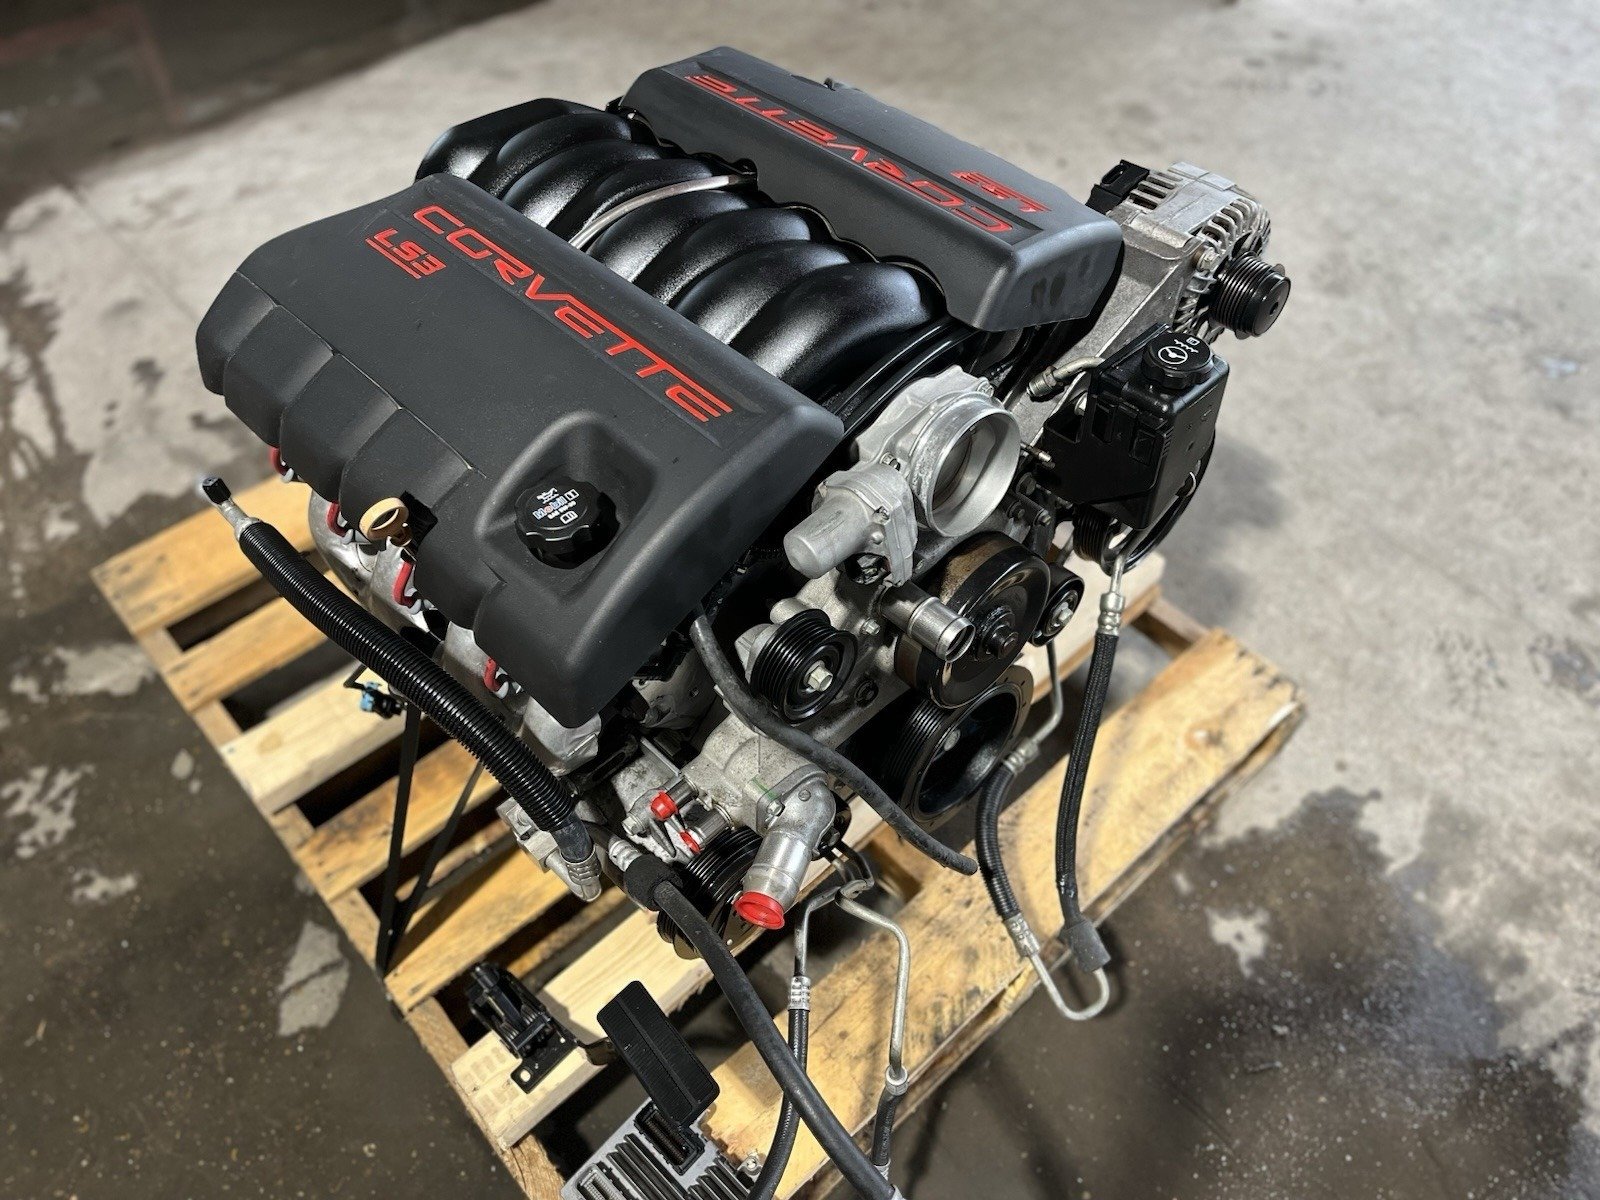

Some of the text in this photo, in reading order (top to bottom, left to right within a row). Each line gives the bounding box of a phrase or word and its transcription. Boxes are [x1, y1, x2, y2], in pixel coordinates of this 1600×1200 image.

[684, 74, 1014, 233] CORVETTE
[952, 170, 1052, 212] LS3
[365, 228, 448, 280] LS3
[412, 203, 734, 423] CORVETTE
